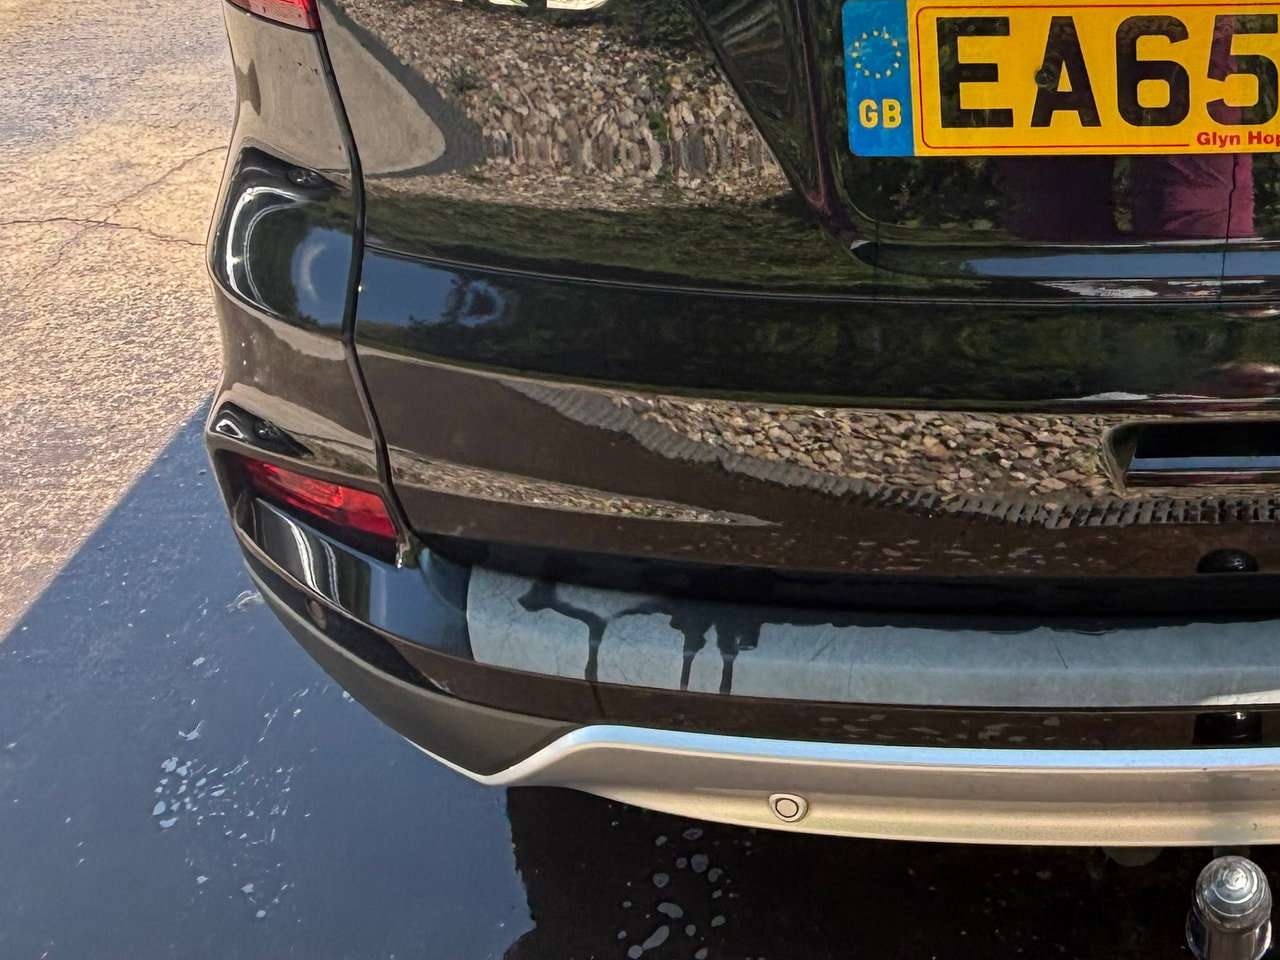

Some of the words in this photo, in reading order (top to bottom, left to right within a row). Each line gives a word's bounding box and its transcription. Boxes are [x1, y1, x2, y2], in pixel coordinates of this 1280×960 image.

[936, 13, 1280, 129] EA65
[859, 99, 901, 128] GB
[1197, 132, 1240, 147] Glyn
